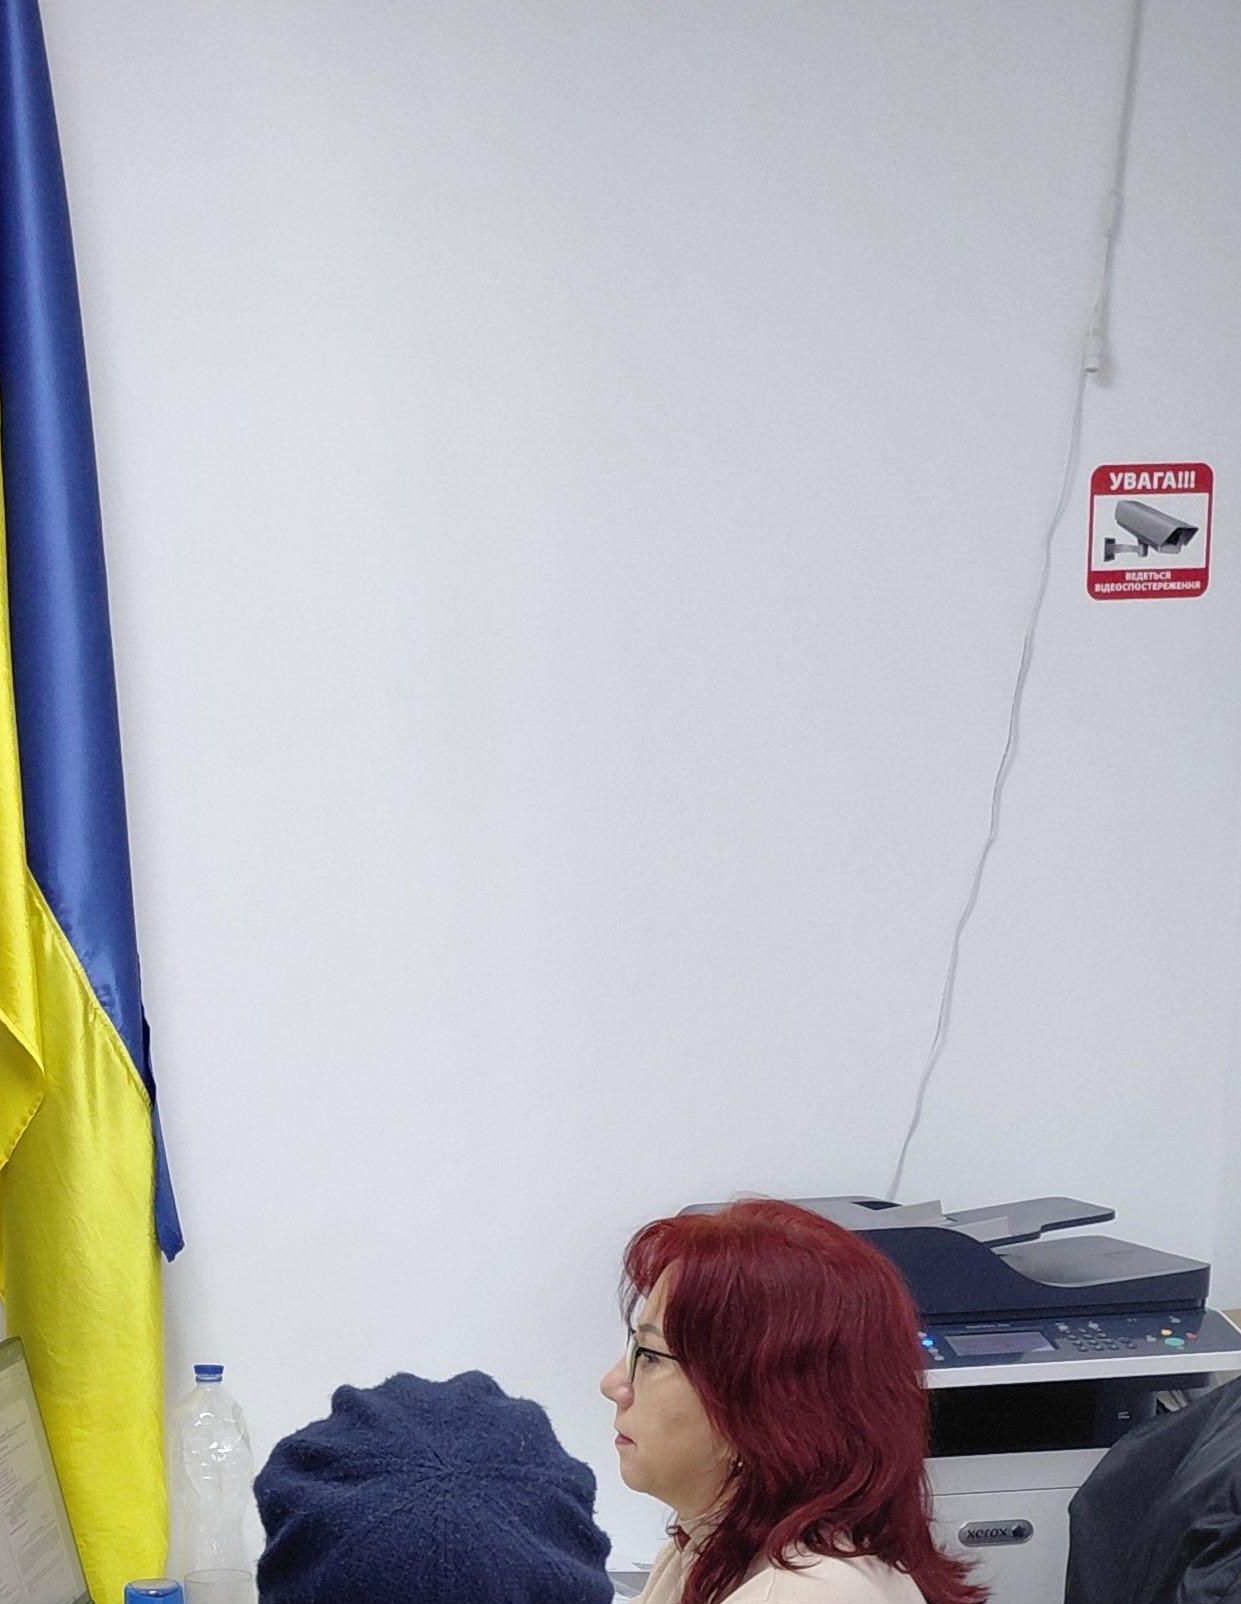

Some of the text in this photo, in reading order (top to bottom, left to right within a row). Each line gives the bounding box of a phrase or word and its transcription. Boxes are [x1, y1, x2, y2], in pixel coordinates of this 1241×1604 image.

[1109, 470, 1196, 491] УВАГА!!!
[1125, 571, 1172, 581] ВЕДЕТЬСЯ
[1094, 581, 1202, 593] ВІДЕОСПОСТЕРЕЖЕННЯ
[966, 1527, 1008, 1539] xerox
